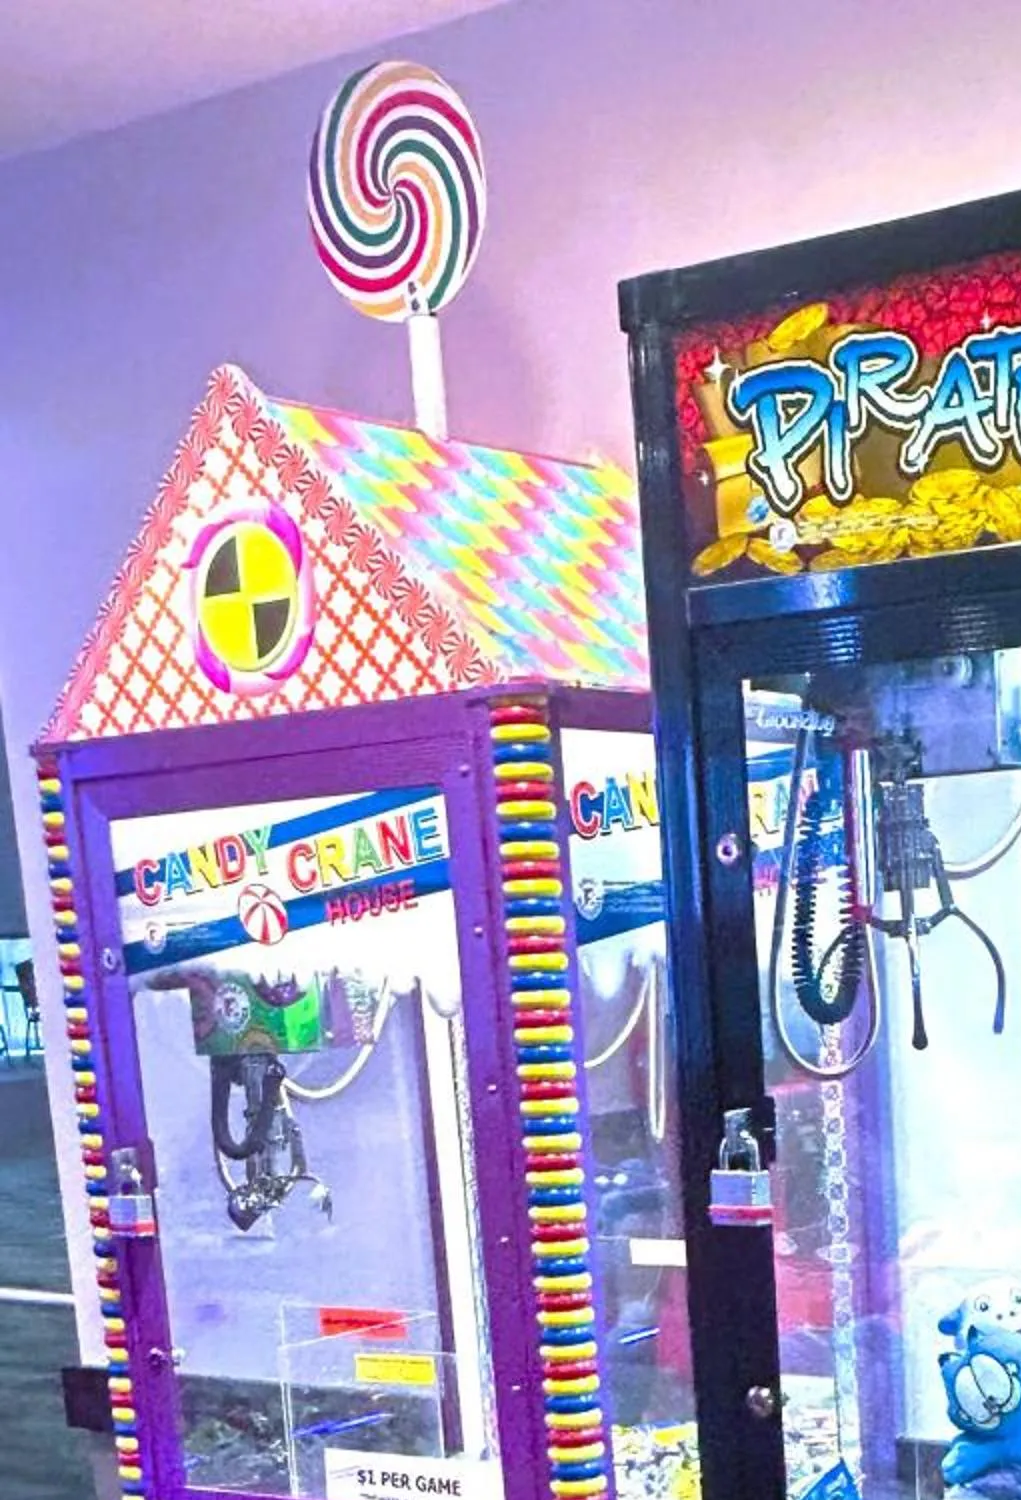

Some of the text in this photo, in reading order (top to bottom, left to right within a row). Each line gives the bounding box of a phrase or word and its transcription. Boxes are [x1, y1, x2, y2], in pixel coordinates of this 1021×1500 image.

[570, 770, 660, 840] CAN
[134, 806, 444, 906] CANDY CRANE
[325, 879, 418, 925] HOUSE
[357, 1470, 462, 1496] $1 PER GAME
